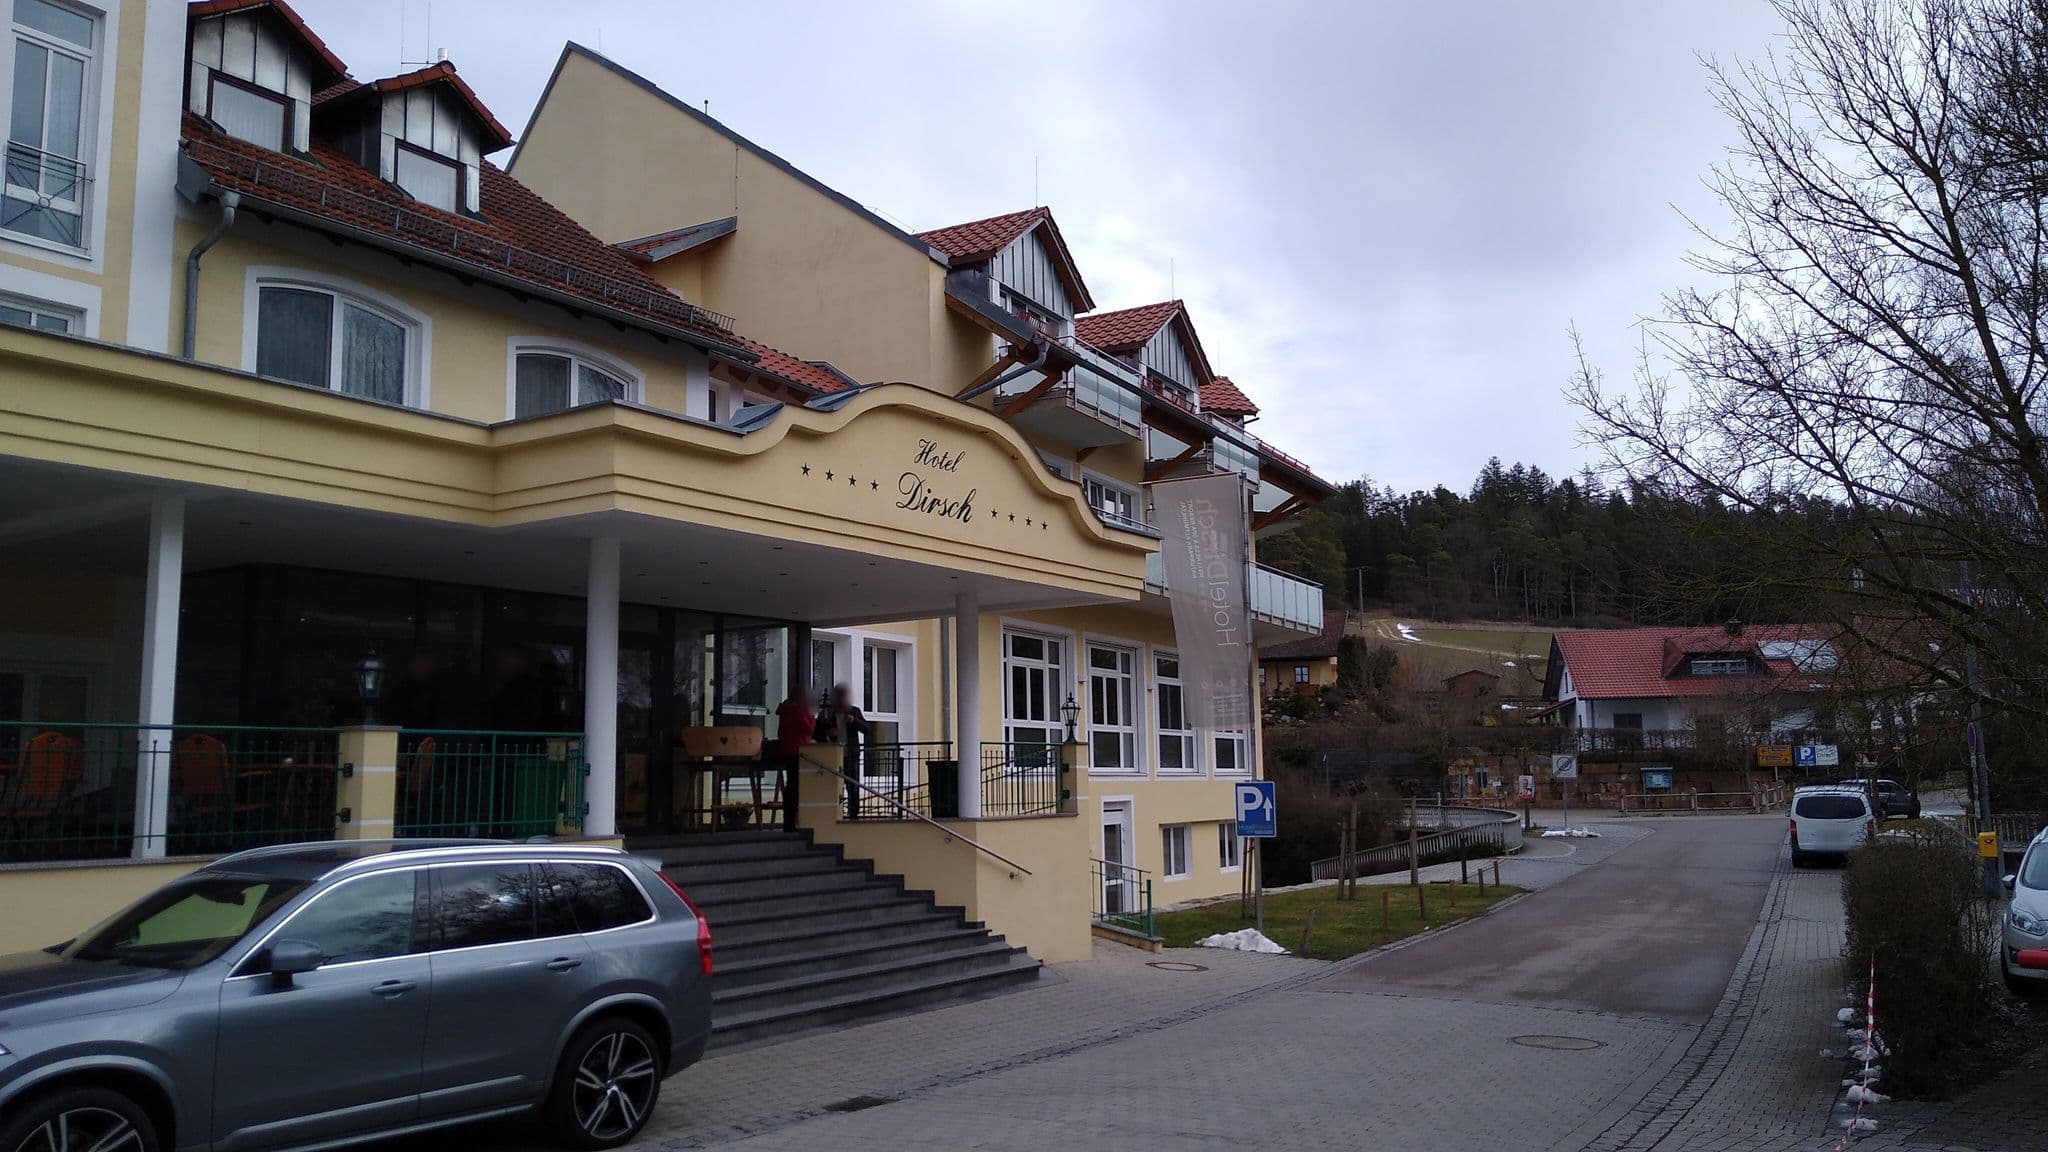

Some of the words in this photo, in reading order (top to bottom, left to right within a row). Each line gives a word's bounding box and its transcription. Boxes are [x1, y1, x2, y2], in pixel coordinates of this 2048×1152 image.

[914, 438, 966, 472] Hotel
[895, 472, 977, 523] Dirsch
[1800, 747, 1811, 760] P
[1237, 786, 1263, 821] P
